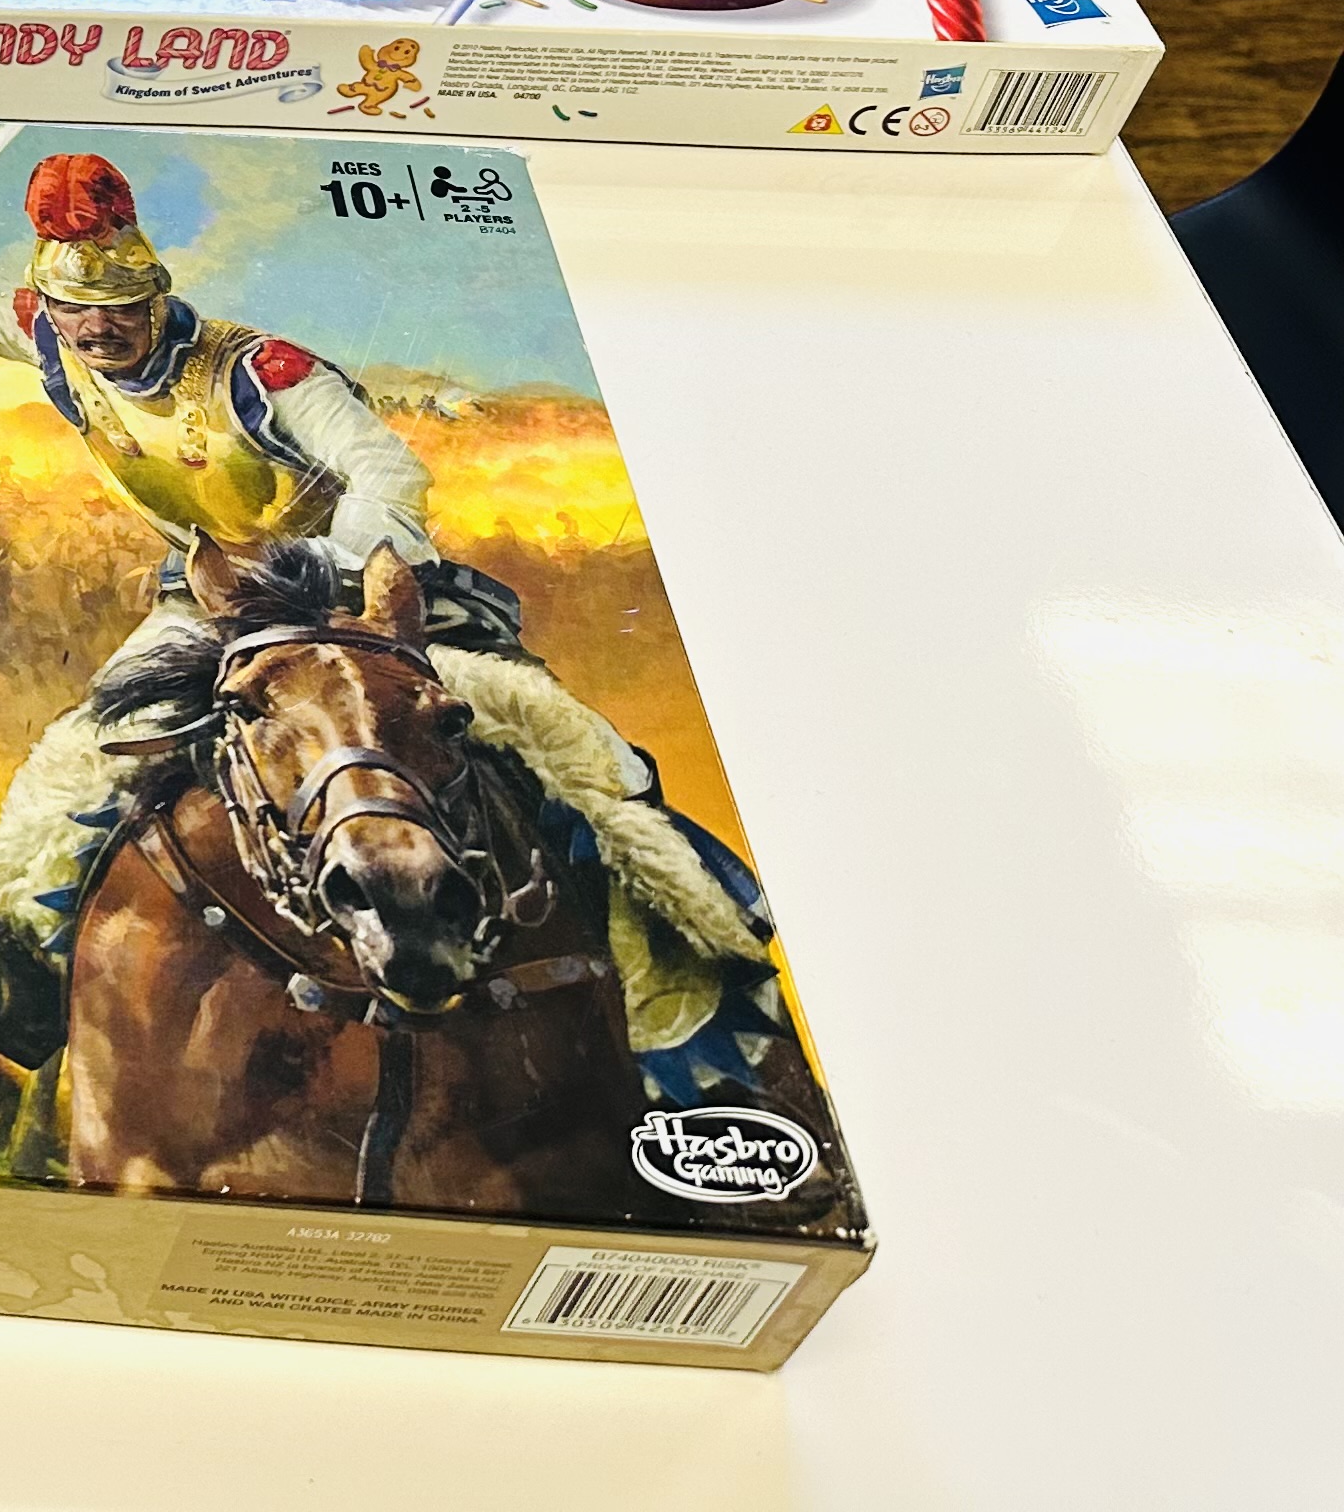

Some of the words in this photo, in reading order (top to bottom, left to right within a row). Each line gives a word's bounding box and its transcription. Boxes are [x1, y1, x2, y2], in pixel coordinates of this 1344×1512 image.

[122, 25, 289, 70] LAND
[116, 85, 170, 99] Kingdom
[175, 87, 187, 97] of
[191, 81, 231, 95] Sweet
[235, 68, 312, 87] Adventures
[331, 162, 382, 176] AGES
[320, 180, 410, 219] 10+
[444, 214, 514, 224] PLAYERS
[639, 1117, 800, 1165] Hasbro
[673, 1152, 784, 1193] Gaming
